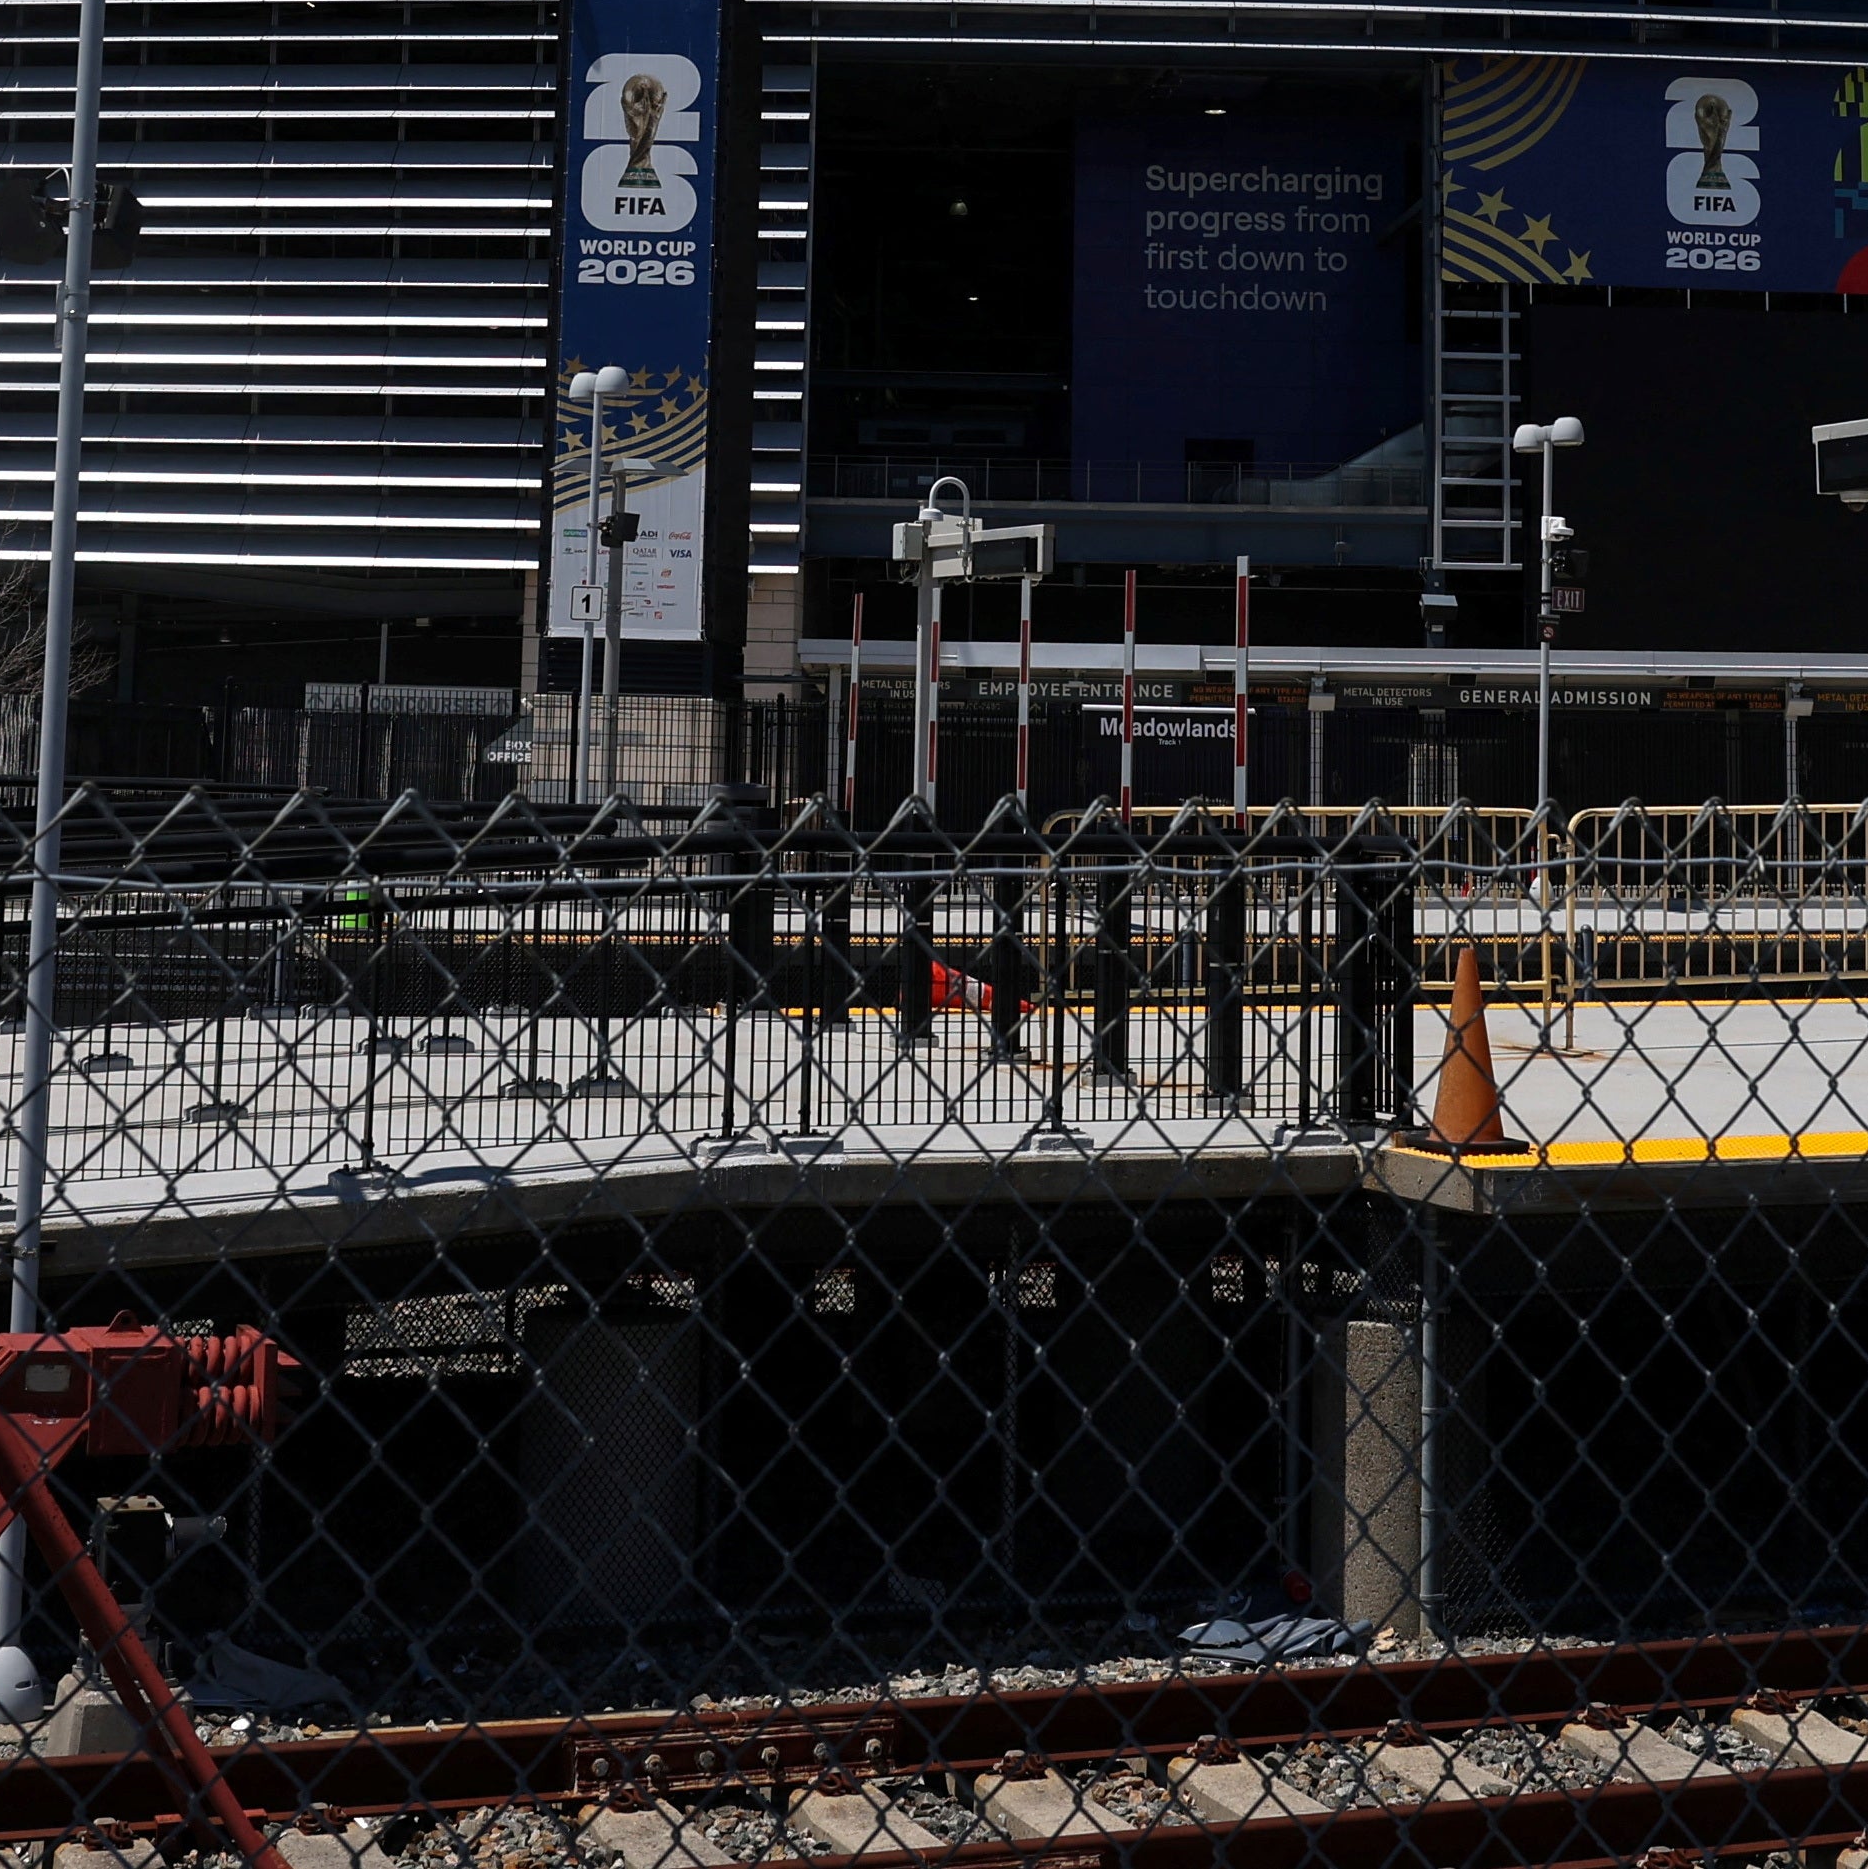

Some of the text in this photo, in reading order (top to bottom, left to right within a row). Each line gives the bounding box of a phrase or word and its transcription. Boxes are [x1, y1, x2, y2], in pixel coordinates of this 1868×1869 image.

[1145, 165, 1383, 200] Supercharging
[615, 197, 666, 215] FIFA
[1693, 196, 1736, 213] FIFA
[1146, 205, 1371, 238] progress from
[1666, 231, 1762, 247] WORLD CUP
[579, 239, 696, 257] WORLD CUP
[1144, 243, 1348, 272] first down to
[1666, 247, 1761, 272] 2026
[577, 259, 696, 286] 2026
[1144, 283, 1328, 311] touchdown
[670, 549, 693, 559] VISA
[581, 594, 591, 613] 1
[1557, 590, 1581, 609] EXIT
[861, 679, 892, 690] METAL
[978, 682, 1072, 697] EMPOYEE
[890, 690, 916, 699] IN US
[1343, 688, 1432, 698] METAL DETECTORS
[1459, 690, 1652, 706] GENERAL ADMISSION
[1817, 693, 1847, 703] METAL
[369, 696, 484, 712] CONCOURSES
[1372, 698, 1404, 707] IN USE
[1845, 703, 1854, 711] IN
[505, 740, 532, 750] BOX
[1158, 738, 1176, 746] Track
[487, 751, 532, 762] OFFICE
